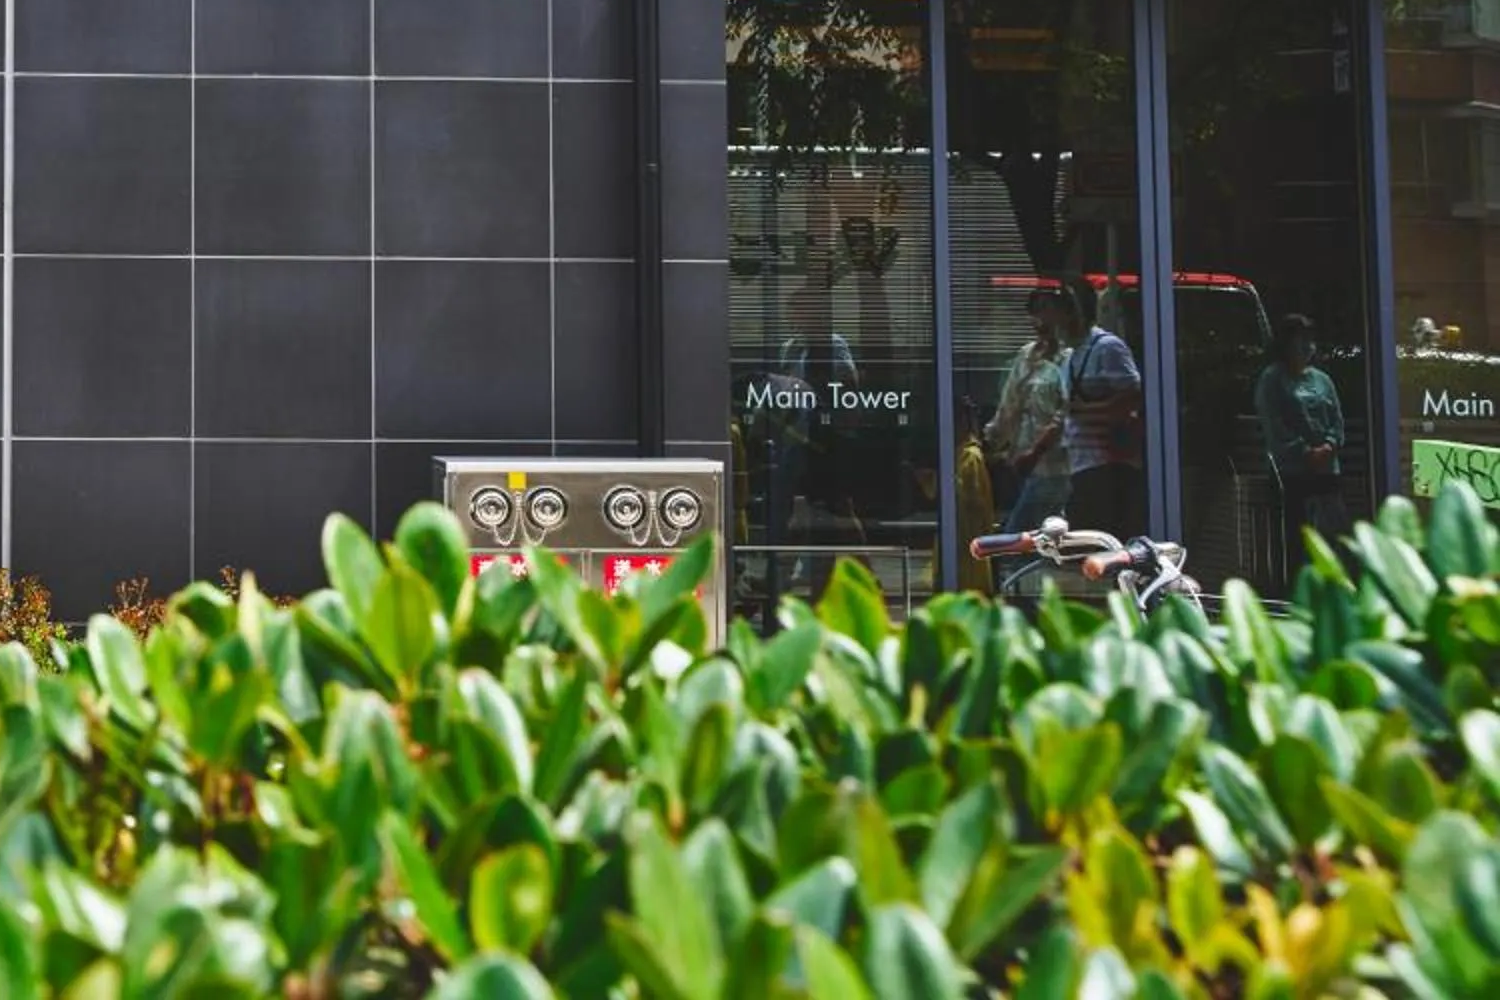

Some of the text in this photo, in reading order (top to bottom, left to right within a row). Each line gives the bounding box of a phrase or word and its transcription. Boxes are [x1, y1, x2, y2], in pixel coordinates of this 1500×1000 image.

[745, 381, 912, 409] Main Tower
[1422, 388, 1495, 417] Main
